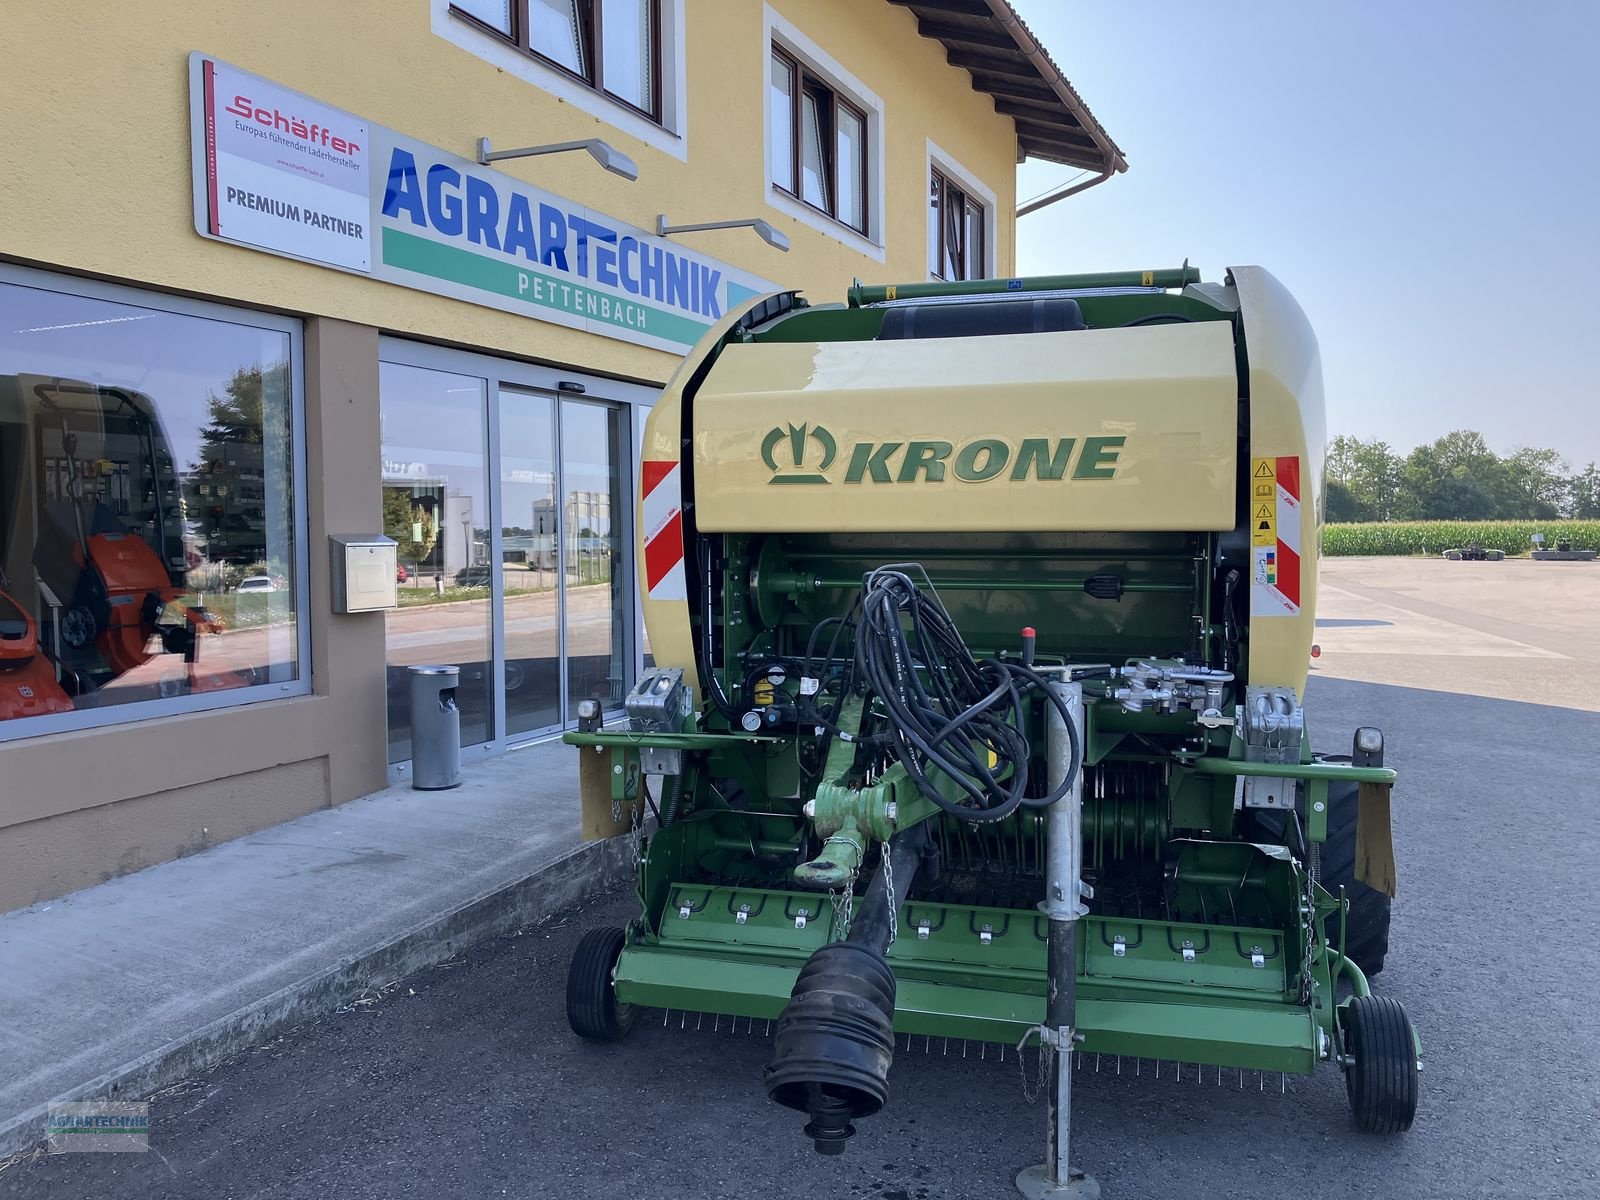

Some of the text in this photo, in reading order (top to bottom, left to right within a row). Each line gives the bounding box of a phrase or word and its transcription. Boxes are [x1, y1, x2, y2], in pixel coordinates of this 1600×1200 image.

[225, 95, 360, 156] Schäffer
[235, 120, 360, 171] Europas führender Laderhersteller
[227, 186, 363, 239] PREMIUM PARTNER
[382, 147, 722, 320] AGRARTECHNIK
[518, 272, 647, 329] PETTENBACH
[843, 436, 1127, 483] KRONE
